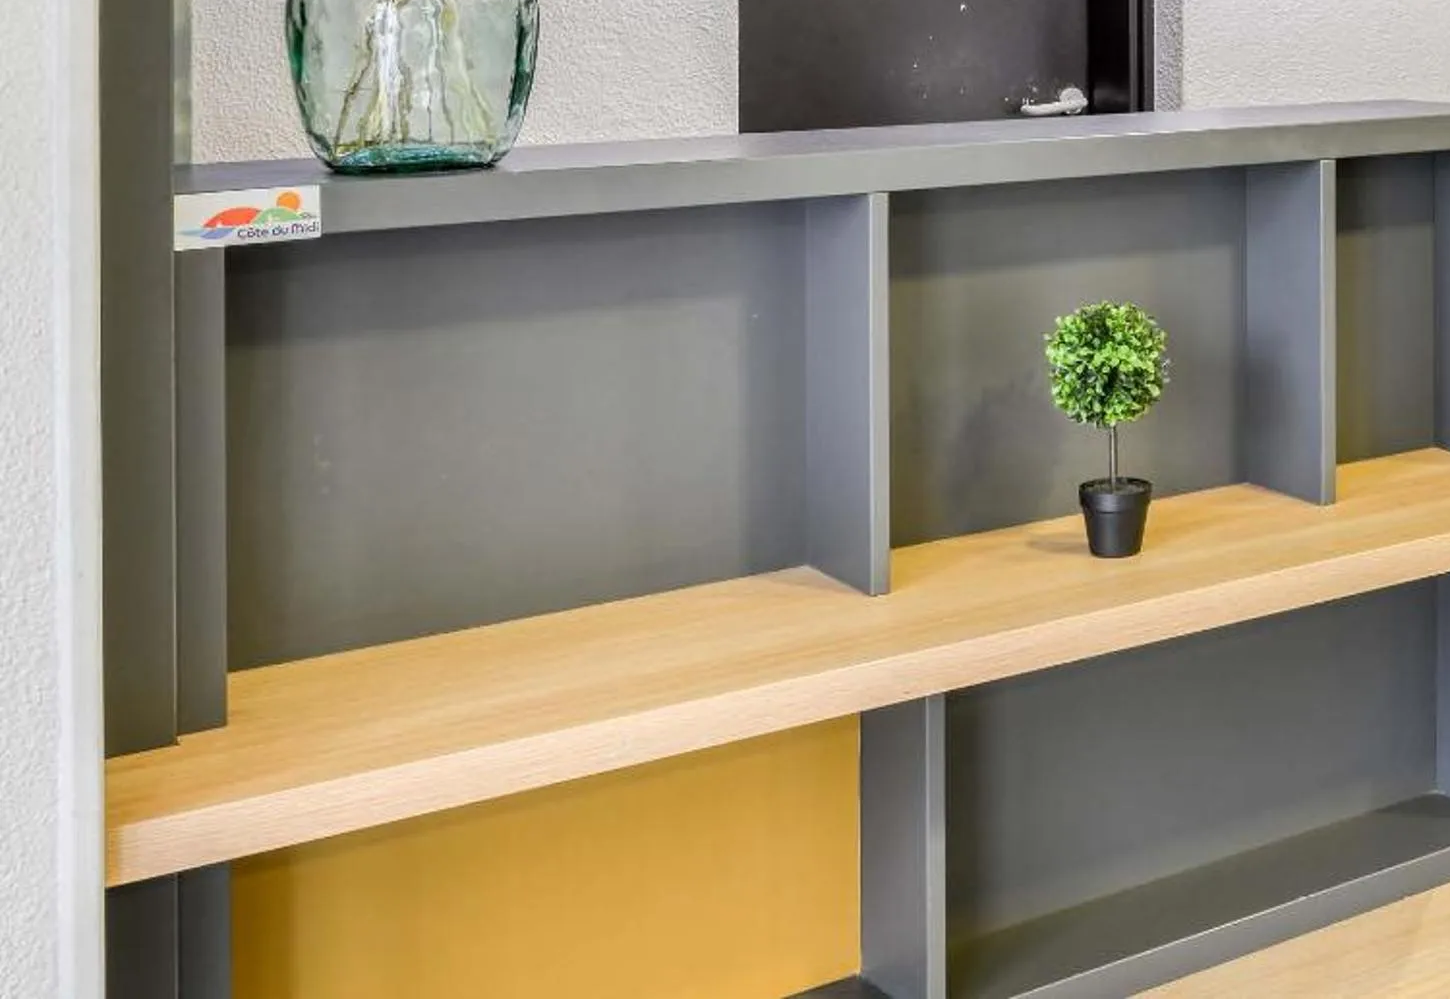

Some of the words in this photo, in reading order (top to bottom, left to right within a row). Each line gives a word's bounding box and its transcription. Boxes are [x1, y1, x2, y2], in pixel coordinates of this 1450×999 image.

[237, 227, 270, 239] Côte
[272, 223, 290, 236] du
[291, 220, 320, 234] Midi
